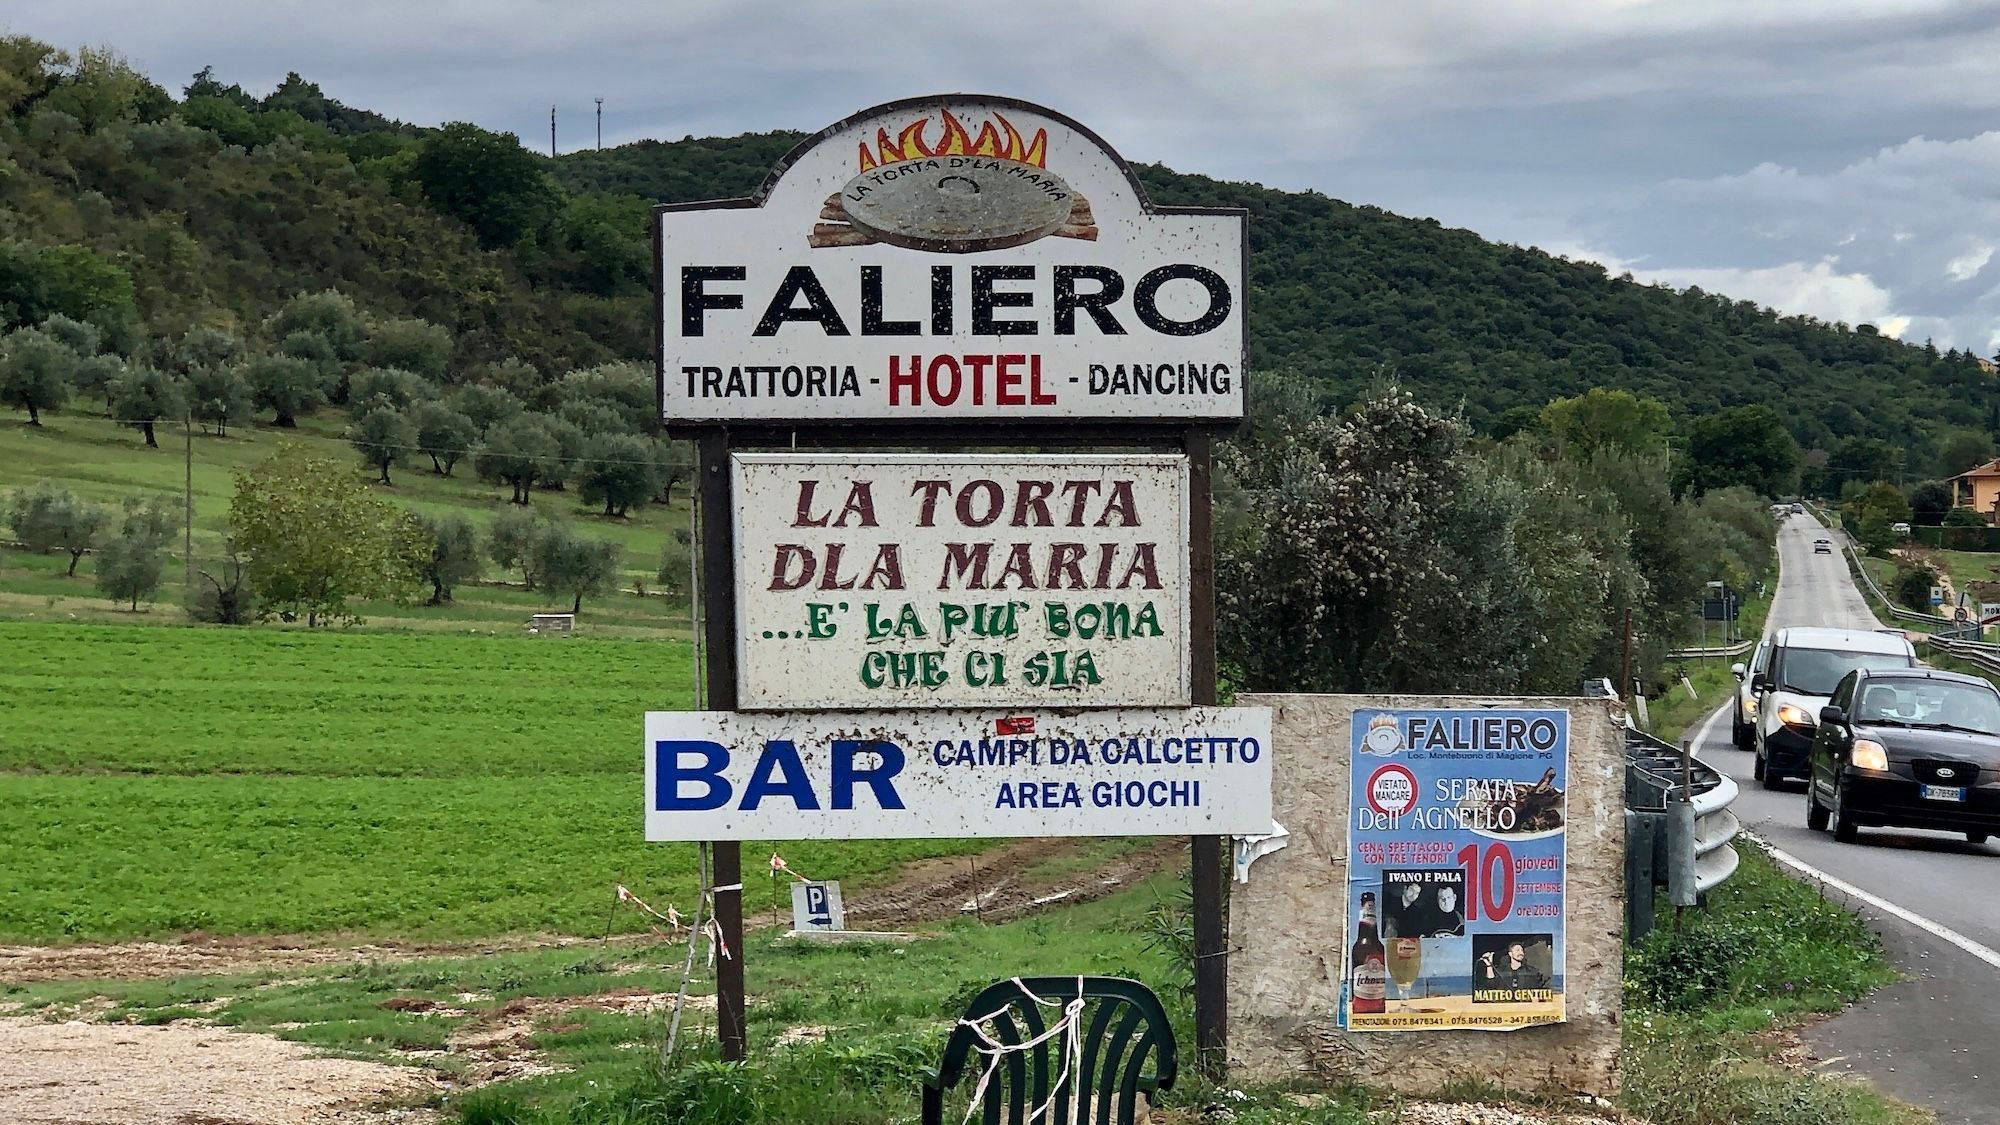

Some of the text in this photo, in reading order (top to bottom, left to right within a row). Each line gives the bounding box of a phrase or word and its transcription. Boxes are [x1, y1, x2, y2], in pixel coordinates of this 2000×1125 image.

[847, 158, 1067, 202] LA TORTA D'LA MARIA
[681, 263, 1232, 337] FALIERO
[682, 365, 861, 397] TRATTORIA
[889, 354, 1057, 406] HOTEL
[1088, 363, 1231, 396] DANCING
[791, 479, 1142, 528] LA TORTA
[767, 542, 1164, 590] DLA MARIA
[864, 602, 927, 639] LA
[1045, 601, 1164, 639] BONA
[860, 649, 1103, 689] CHE CI SIA
[1408, 718, 1558, 750] FALIERO
[933, 736, 1260, 767] CAMPI DA CALCETTO
[1408, 752, 1427, 760] Loc.
[1485, 752, 1494, 760] di
[1496, 752, 1533, 761] Magione
[1539, 752, 1553, 760] PG
[655, 740, 906, 811] BAR
[1377, 779, 1408, 789] VIETATO
[996, 780, 1200, 808] AREA GIOCHI
[1375, 790, 1410, 800] MANCARE
[1435, 778, 1517, 801] SERATA
[1358, 806, 1517, 831] Dell' AGNELLO
[1358, 842, 1454, 853] CENA SPETTACOLO
[1364, 853, 1449, 864] CON TRE TENORI
[1389, 872, 1462, 883] IVANO E PALA
[1457, 841, 1516, 923] 10
[1516, 882, 1561, 894] SETTEMBRE
[808, 888, 824, 913] P
[1516, 907, 1532, 917] ore
[1474, 989, 1553, 1001] MATTEO GENTILI
